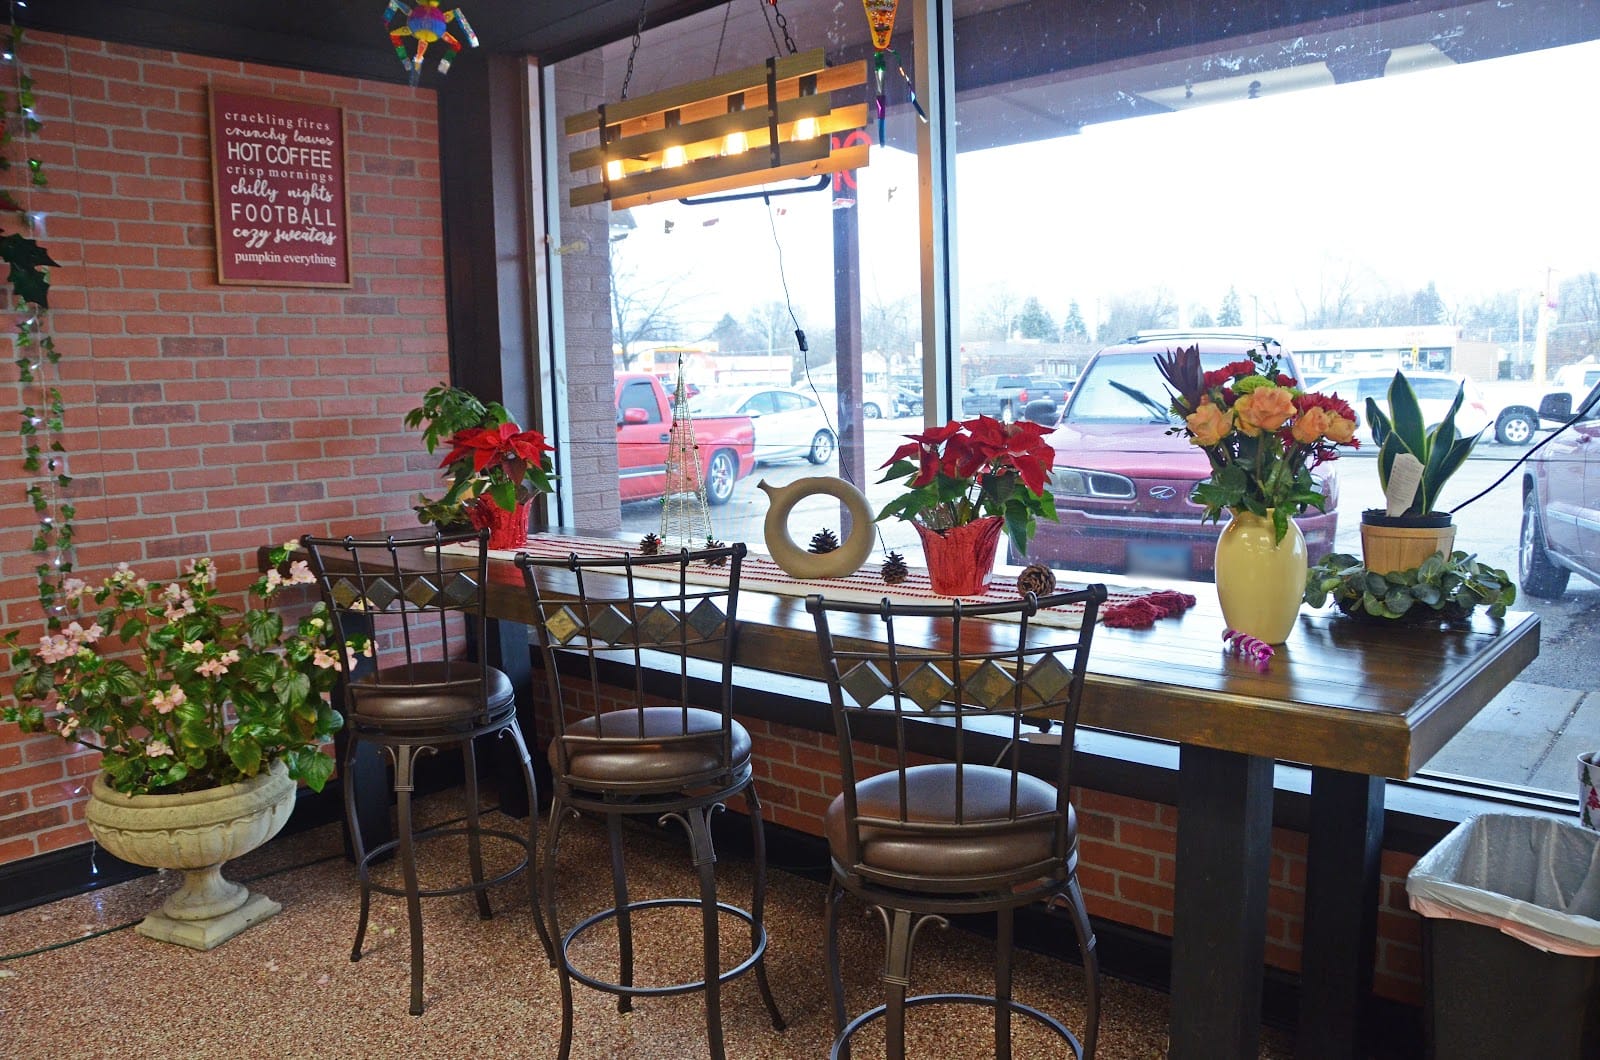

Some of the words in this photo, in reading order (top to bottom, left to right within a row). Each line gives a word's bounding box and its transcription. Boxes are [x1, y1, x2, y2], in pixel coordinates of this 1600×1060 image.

[225, 112, 293, 128] crackling
[297, 118, 330, 131] fires
[225, 127, 288, 144] crunchy
[294, 131, 334, 146] leaves
[227, 141, 262, 162] HOT
[266, 145, 332, 168] COFFEE
[226, 164, 264, 178] crisp
[269, 167, 334, 184] mornings
[231, 177, 279, 203] chilly
[287, 183, 334, 205] nights
[231, 203, 337, 226] FOOTBALL
[233, 228, 272, 248] cozy
[274, 226, 337, 246] sweaters
[235, 251, 281, 265] pumpkin
[283, 253, 337, 267] everything
